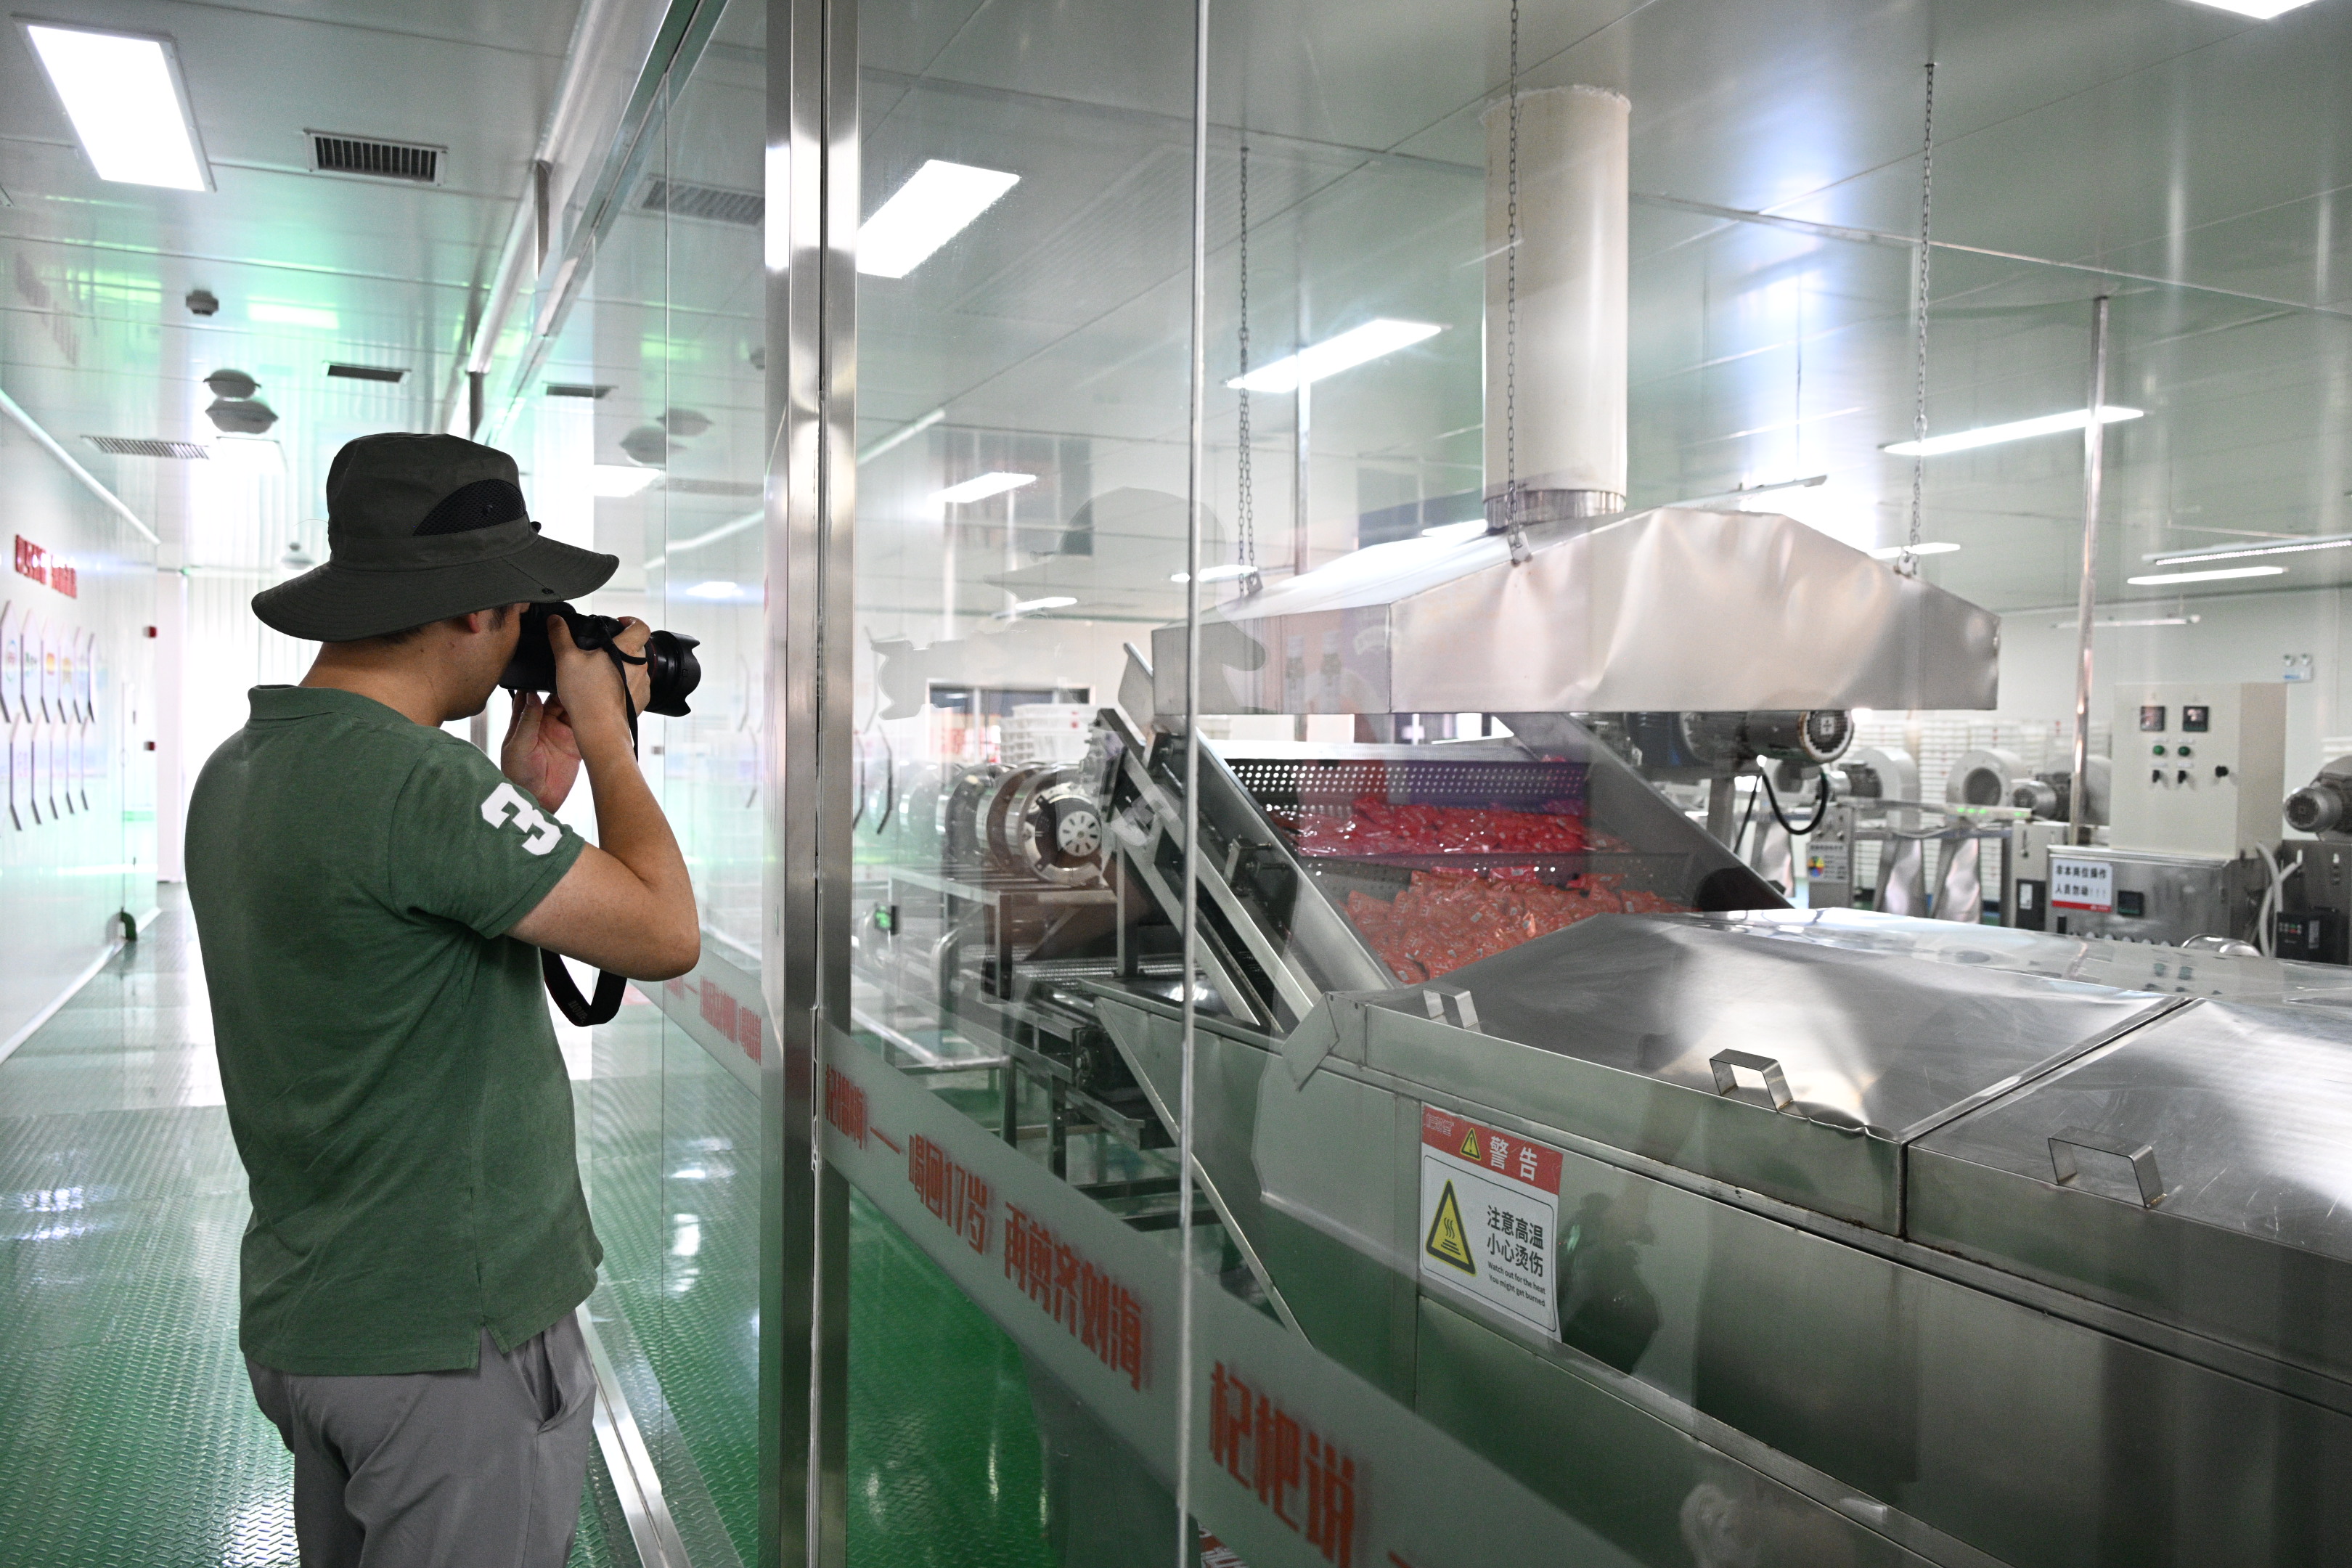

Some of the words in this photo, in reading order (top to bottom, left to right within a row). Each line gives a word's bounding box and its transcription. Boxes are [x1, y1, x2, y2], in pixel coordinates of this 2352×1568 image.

[481, 782, 563, 856] 3
[1490, 1135, 1538, 1182] 警告
[1487, 1204, 1544, 1251] 注意高温
[1487, 1233, 1543, 1278] 小心烫伤
[1488, 1260, 1504, 1275] Watch
[1505, 1268, 1514, 1280] out
[1523, 1278, 1532, 1289] the
[1533, 1281, 1546, 1295] heat
[1489, 1273, 1499, 1285] You
[1500, 1279, 1516, 1292] might
[1516, 1286, 1525, 1297] get
[1526, 1291, 1545, 1307] burned
